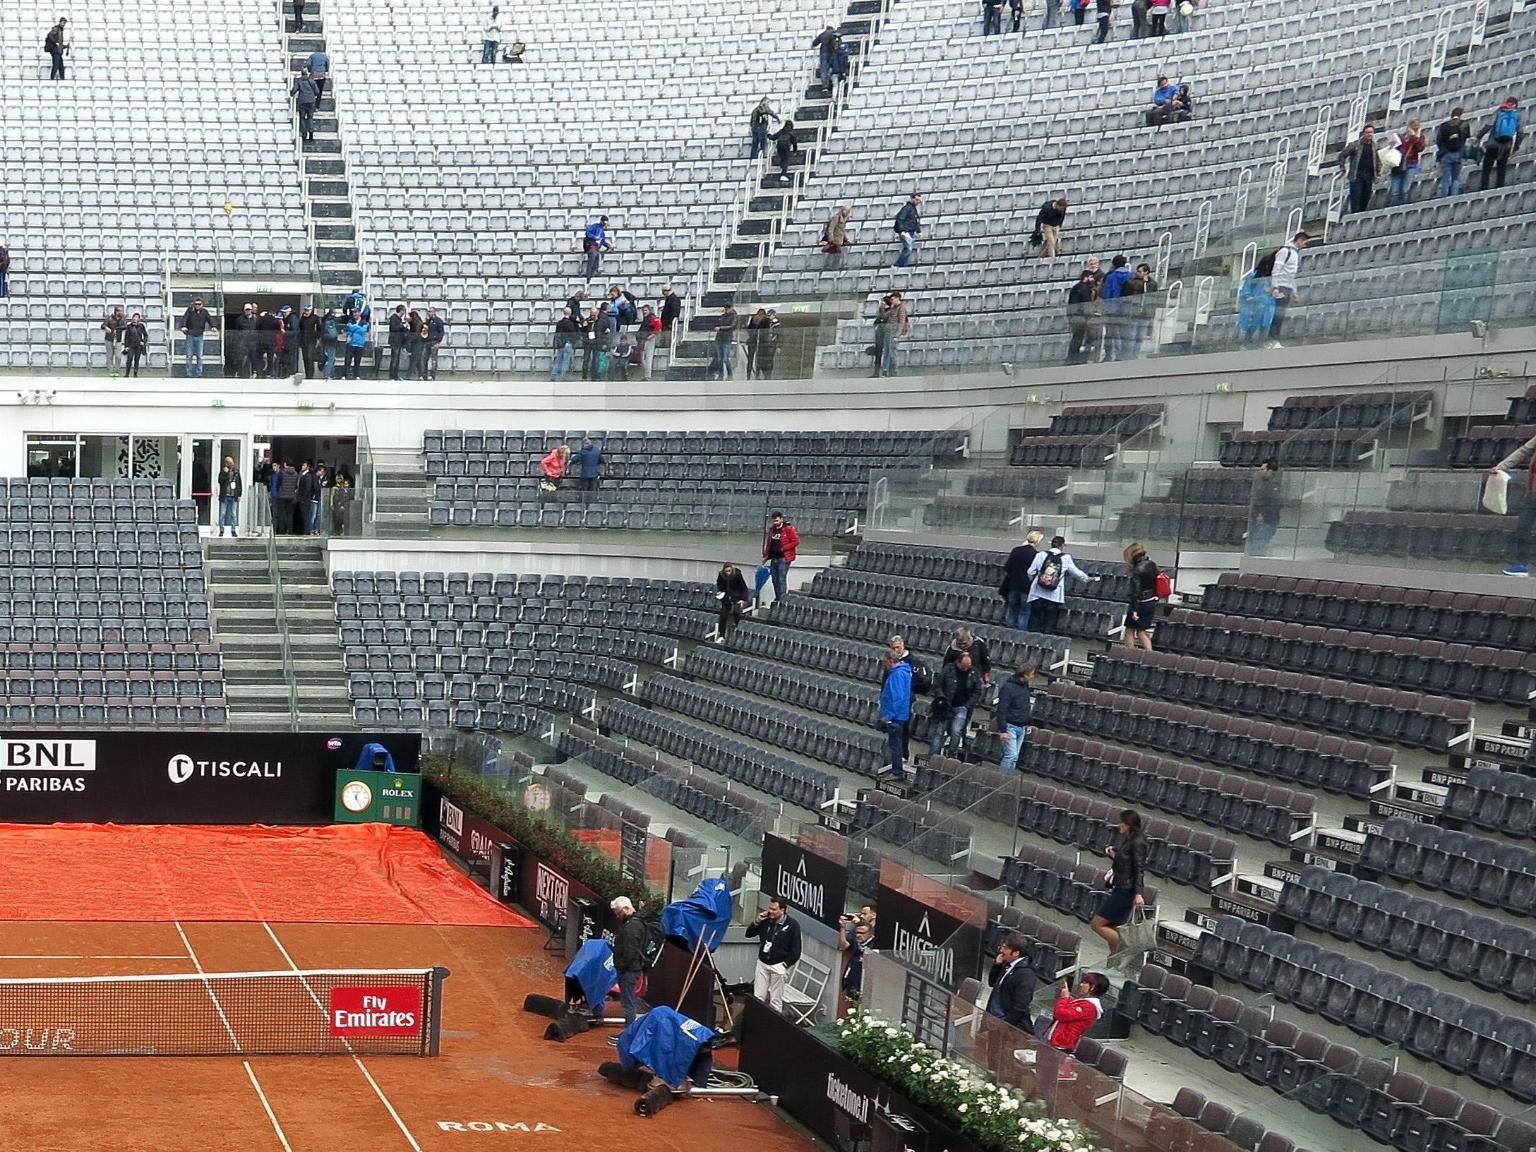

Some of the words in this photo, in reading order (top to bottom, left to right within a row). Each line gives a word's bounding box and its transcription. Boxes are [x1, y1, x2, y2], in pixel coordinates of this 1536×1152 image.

[7, 742, 85, 767] BNL
[196, 761, 282, 777] TISCALI
[6, 777, 85, 791] PARIBAS
[382, 788, 414, 798] ROLEX
[536, 867, 554, 900] NEXT
[777, 864, 824, 918] LEVISSIMA
[893, 922, 954, 985] LEVISSIMA
[363, 995, 387, 1010] Fly
[334, 1009, 415, 1027] Emirates
[436, 1121, 562, 1132] ROMA
